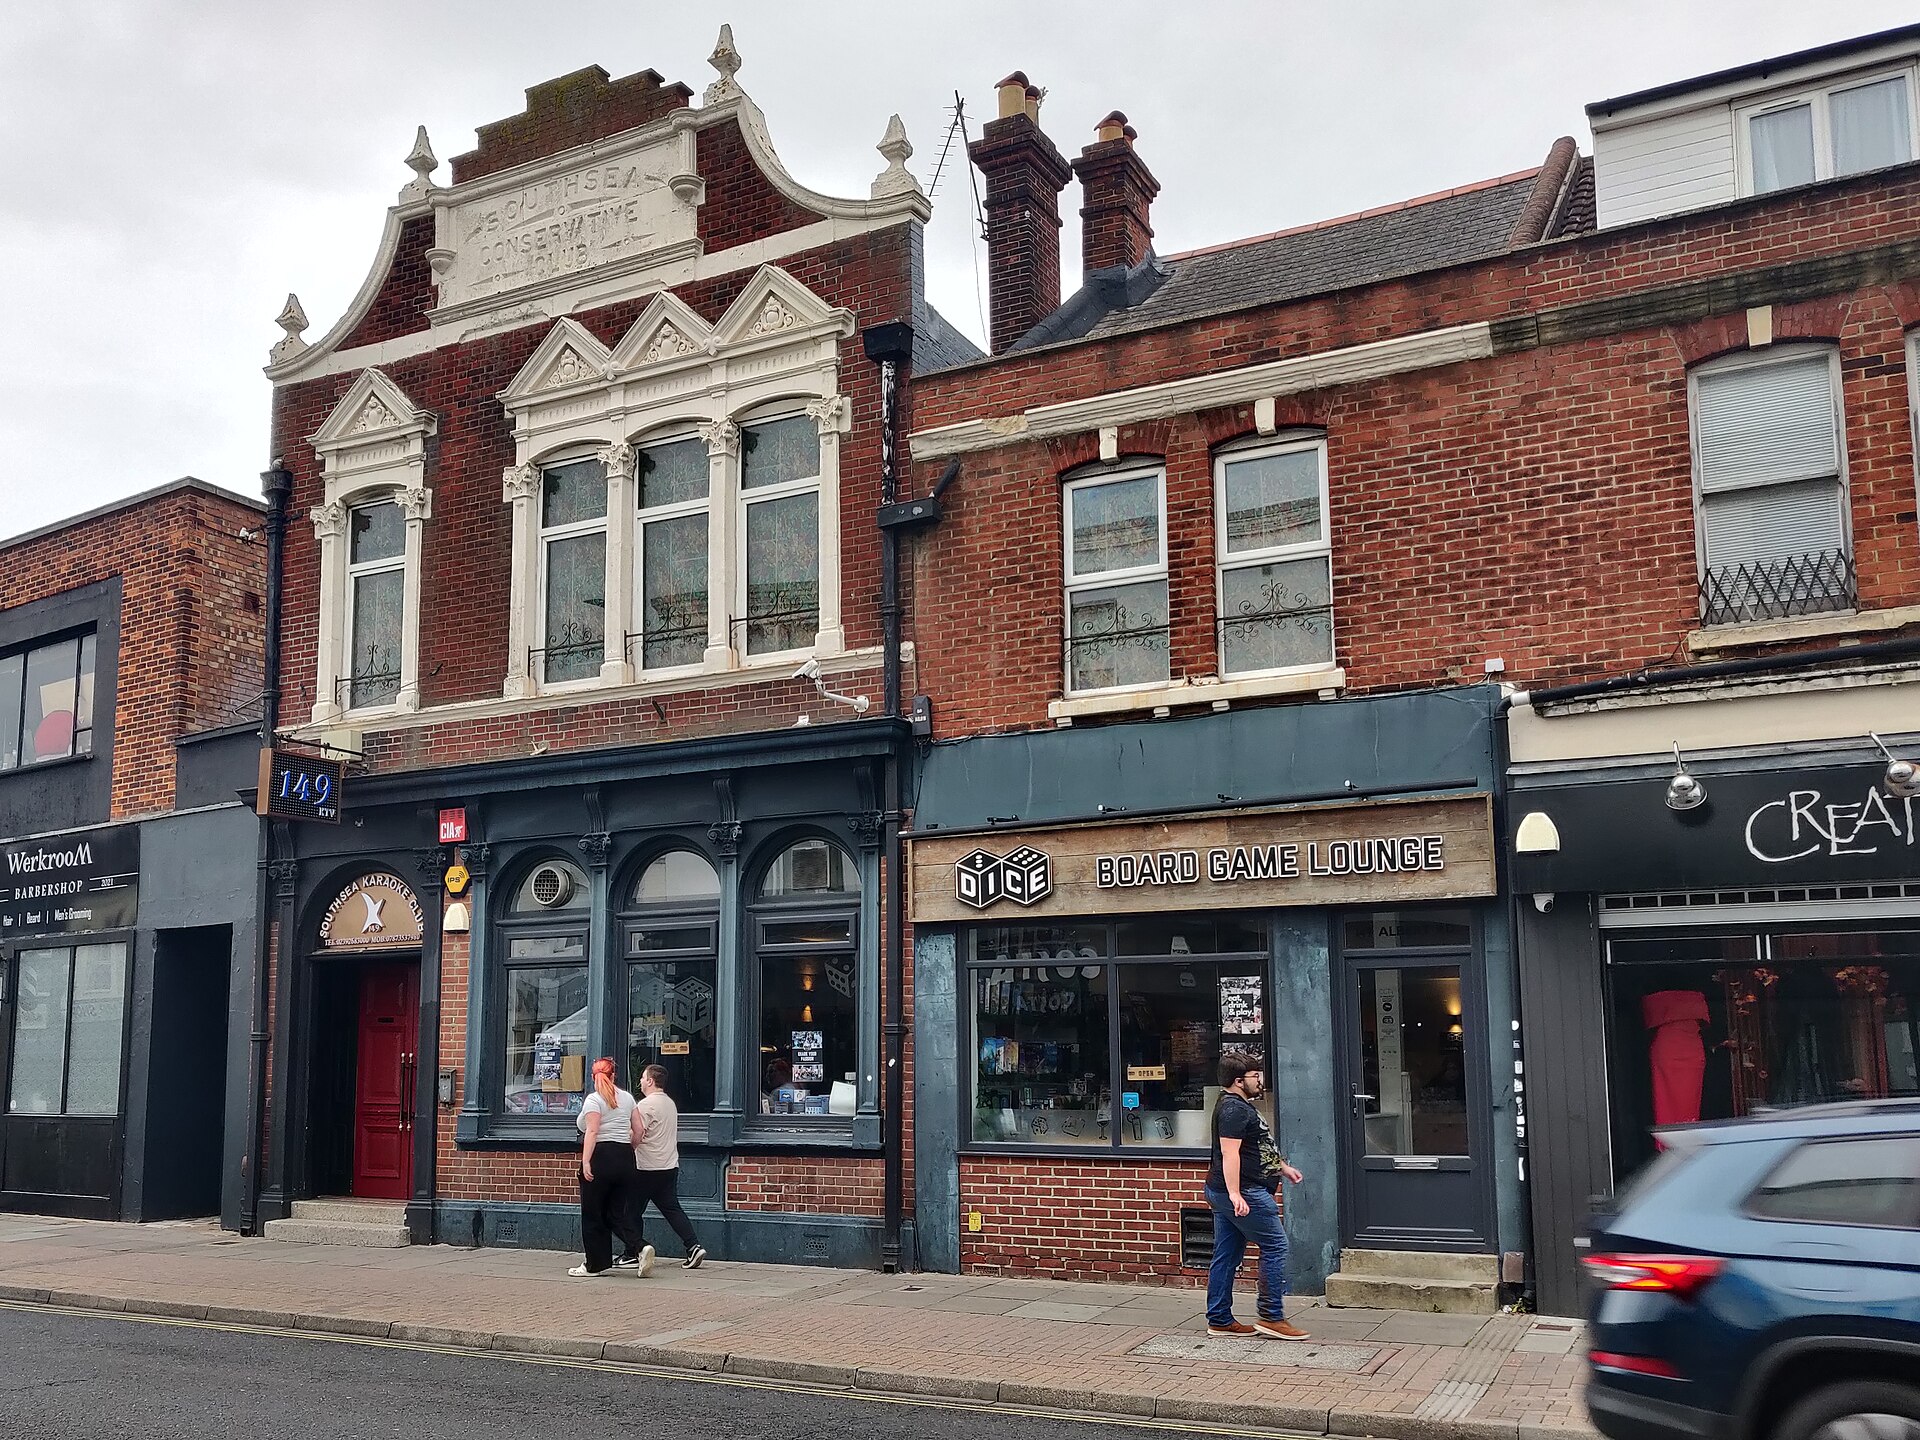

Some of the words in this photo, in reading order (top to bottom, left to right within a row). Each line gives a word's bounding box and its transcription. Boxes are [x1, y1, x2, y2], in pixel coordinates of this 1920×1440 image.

[485, 166, 640, 233] SOUTHSEA
[481, 200, 639, 266] CONSERVATIVE
[534, 243, 588, 275] CLUB
[280, 771, 331, 806] 149
[441, 822, 455, 839] CIA
[1097, 851, 1199, 888] BOARD
[1208, 845, 1299, 882] GAME
[1308, 836, 1443, 876] LOUNGE
[15, 880, 83, 900] BARBERSHOP
[101, 878, 114, 887] 2021
[960, 866, 1046, 898] DICE
[3, 915, 14, 926] Hair
[27, 912, 41, 924] Beard
[55, 907, 69, 921] Men's
[69, 907, 92, 921] Grooming
[320, 881, 359, 938] SOUTHSEA
[362, 875, 412, 901] KARAOKE
[1236, 1008, 1254, 1017] play.
